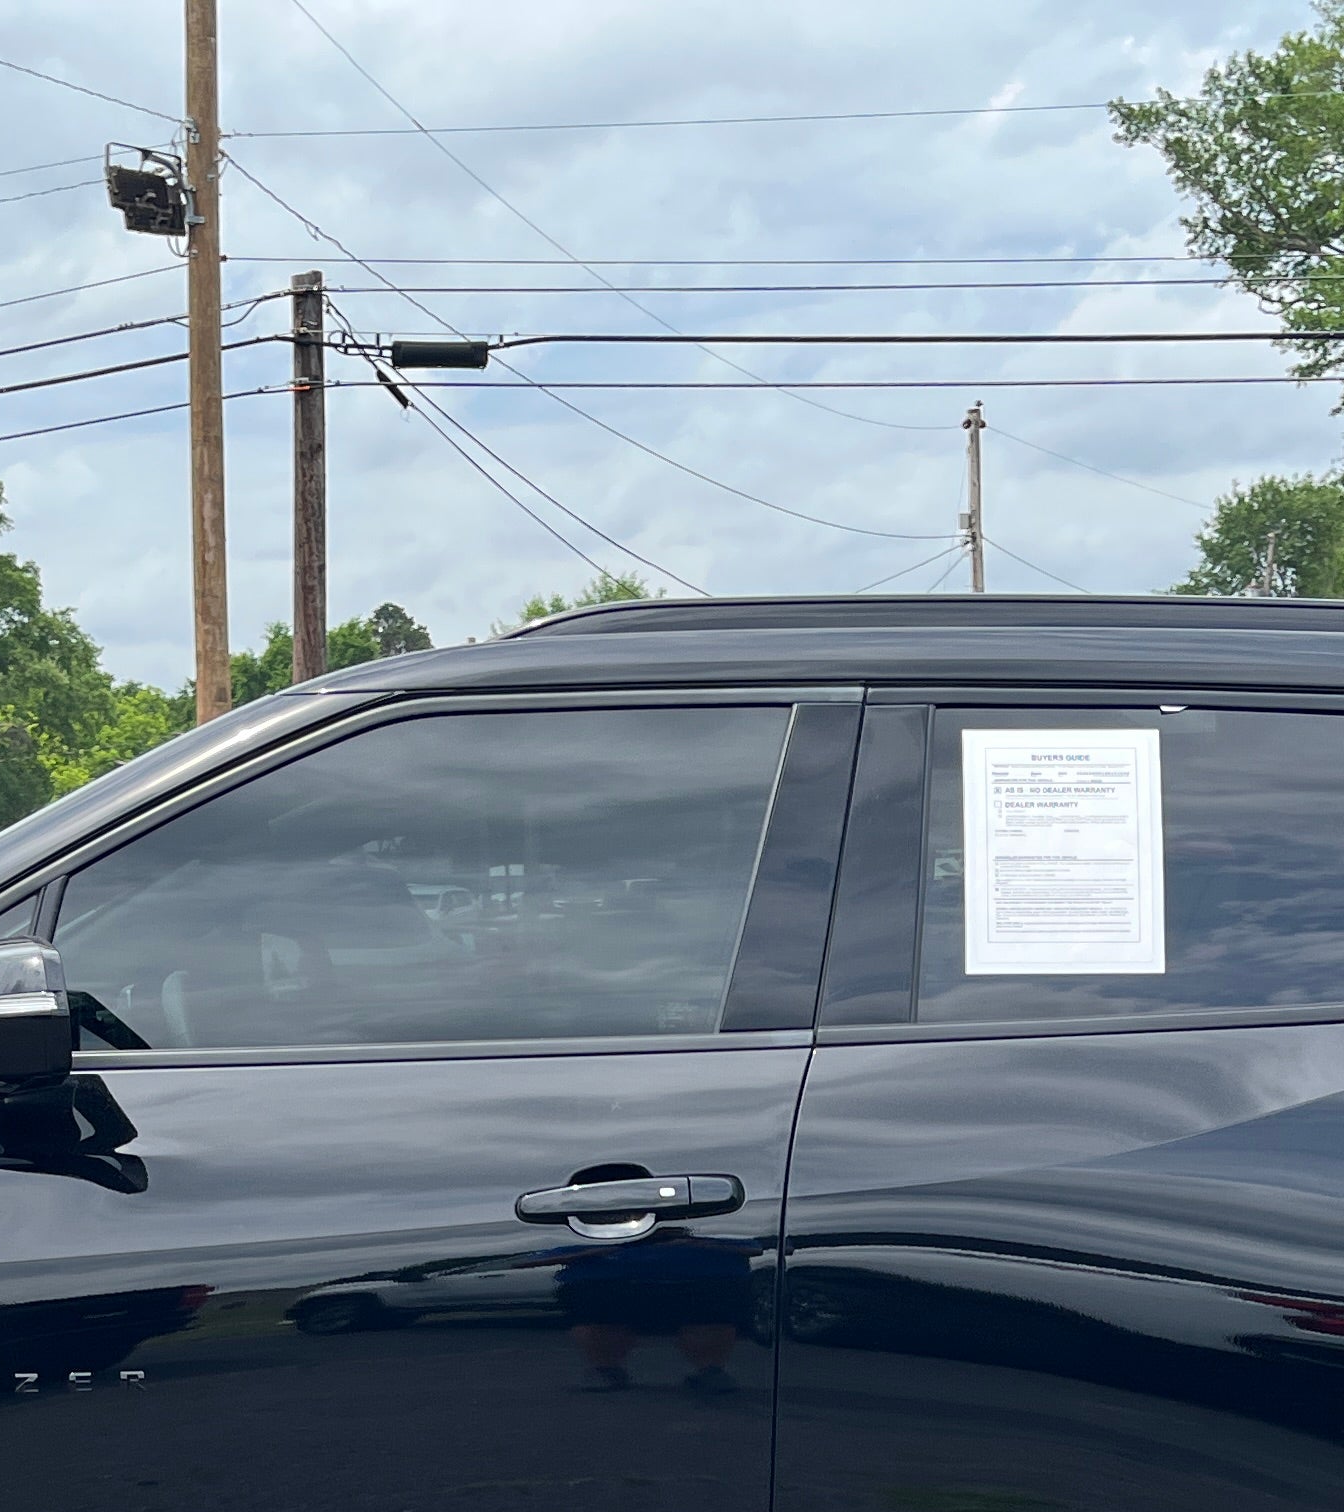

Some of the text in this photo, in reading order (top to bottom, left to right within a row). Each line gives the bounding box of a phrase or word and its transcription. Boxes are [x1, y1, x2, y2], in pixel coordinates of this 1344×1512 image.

[1031, 754, 1091, 762] BUYERS GUIDE
[1005, 786, 1015, 794] AS
[1030, 786, 1041, 794] NO
[1042, 786, 1072, 794] DEALER
[1073, 786, 1116, 794] WARRANTY
[1004, 801, 1079, 809] DEALER WARRANTY
